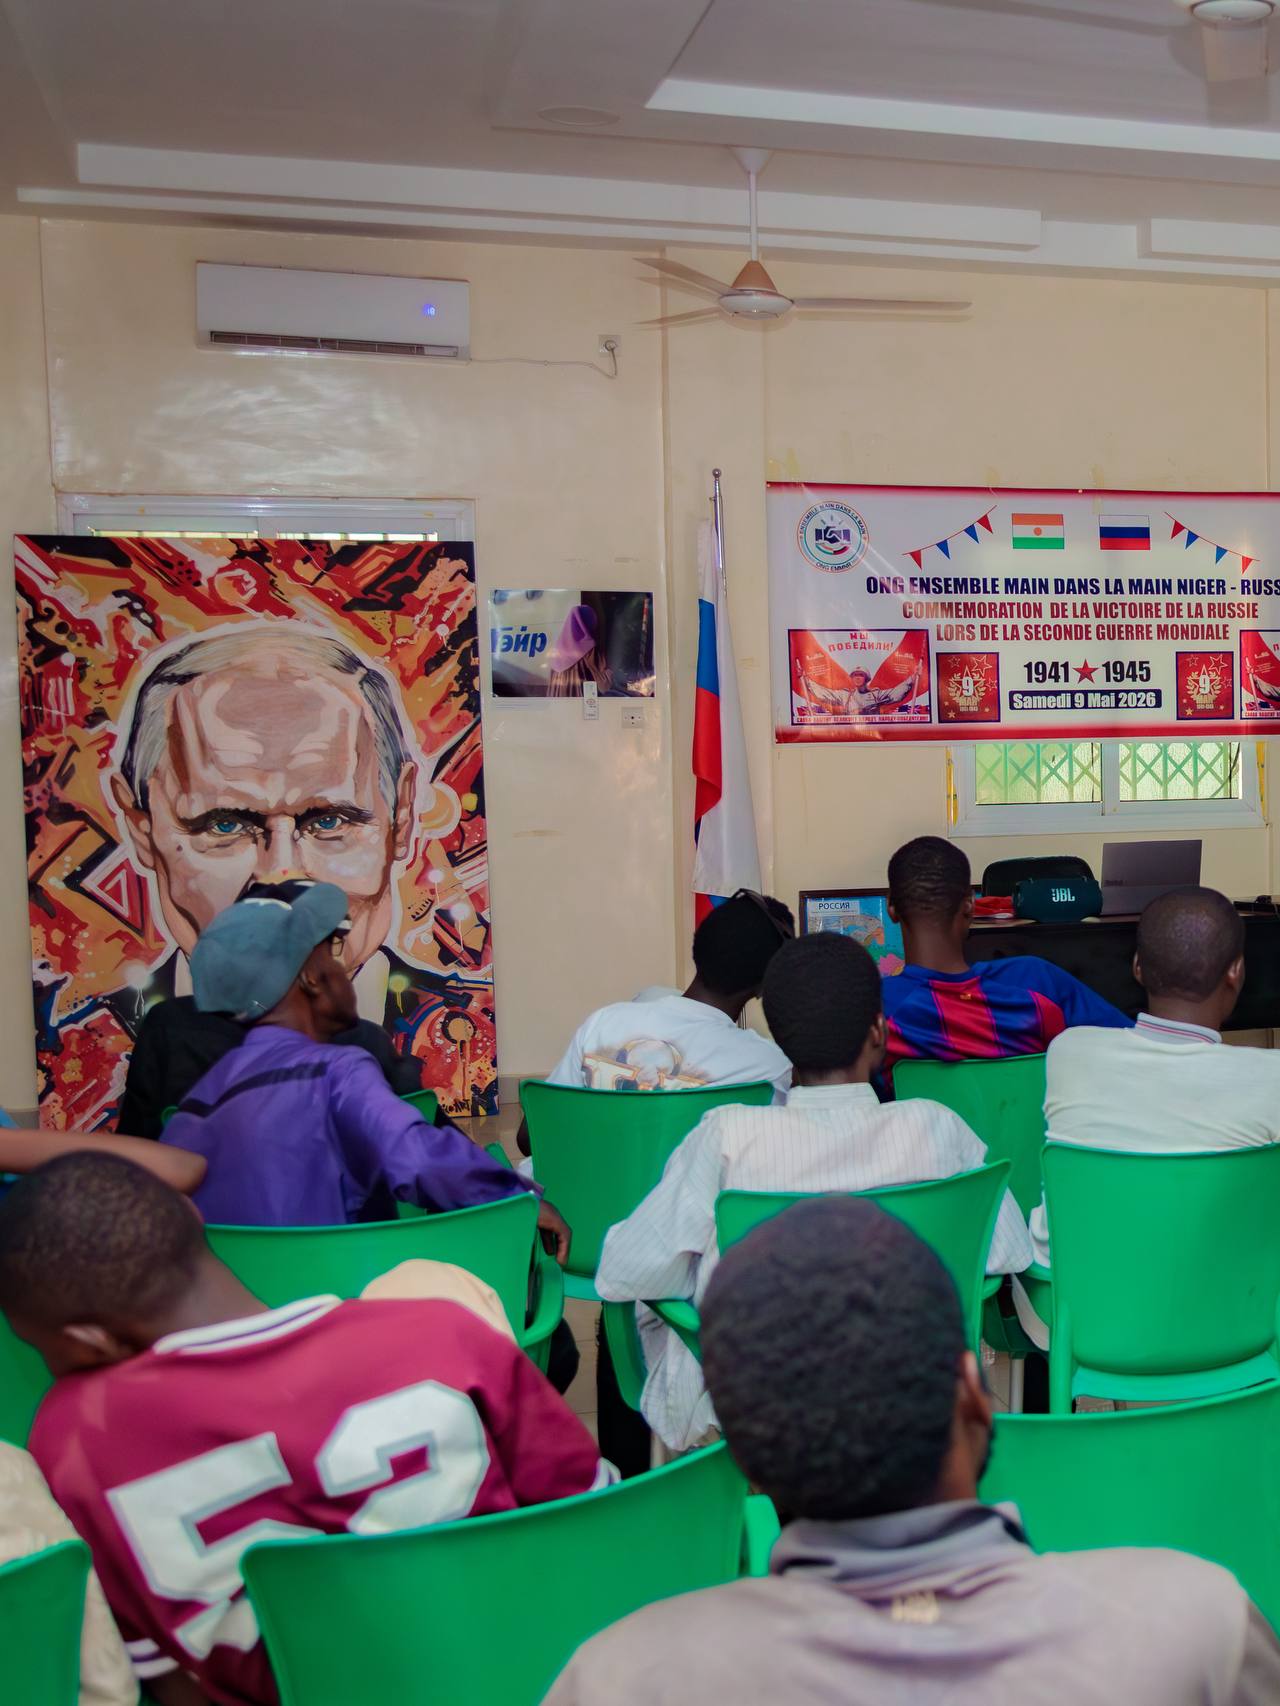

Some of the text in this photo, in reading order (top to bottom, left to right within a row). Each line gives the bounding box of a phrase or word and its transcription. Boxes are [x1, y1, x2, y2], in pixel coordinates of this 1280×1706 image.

[866, 576, 905, 595] ONG
[910, 576, 1000, 595] ENSEMBLE
[1004, 577, 1050, 595] MAIN
[1053, 577, 1101, 596] DANS
[1105, 578, 1126, 595] LA
[1128, 578, 1174, 596] MAIN
[1177, 578, 1228, 596] NIGER
[902, 601, 1260, 619] COMMEMORATION DE LA VICTOIRE DE LA RUSSIE
[936, 623, 1230, 642] LORS DE LA SECONDE GUERRE MONDIALE
[828, 641, 895, 653] ПОБЕДИЛИ!
[1023, 660, 1152, 684] 1941 1945
[962, 676, 974, 697] 9
[1198, 674, 1211, 695] 9
[1012, 691, 1157, 709] Samedi 9 Mai 2026
[1051, 887, 1076, 903] JBL
[818, 901, 850, 910] РОССИЯ
